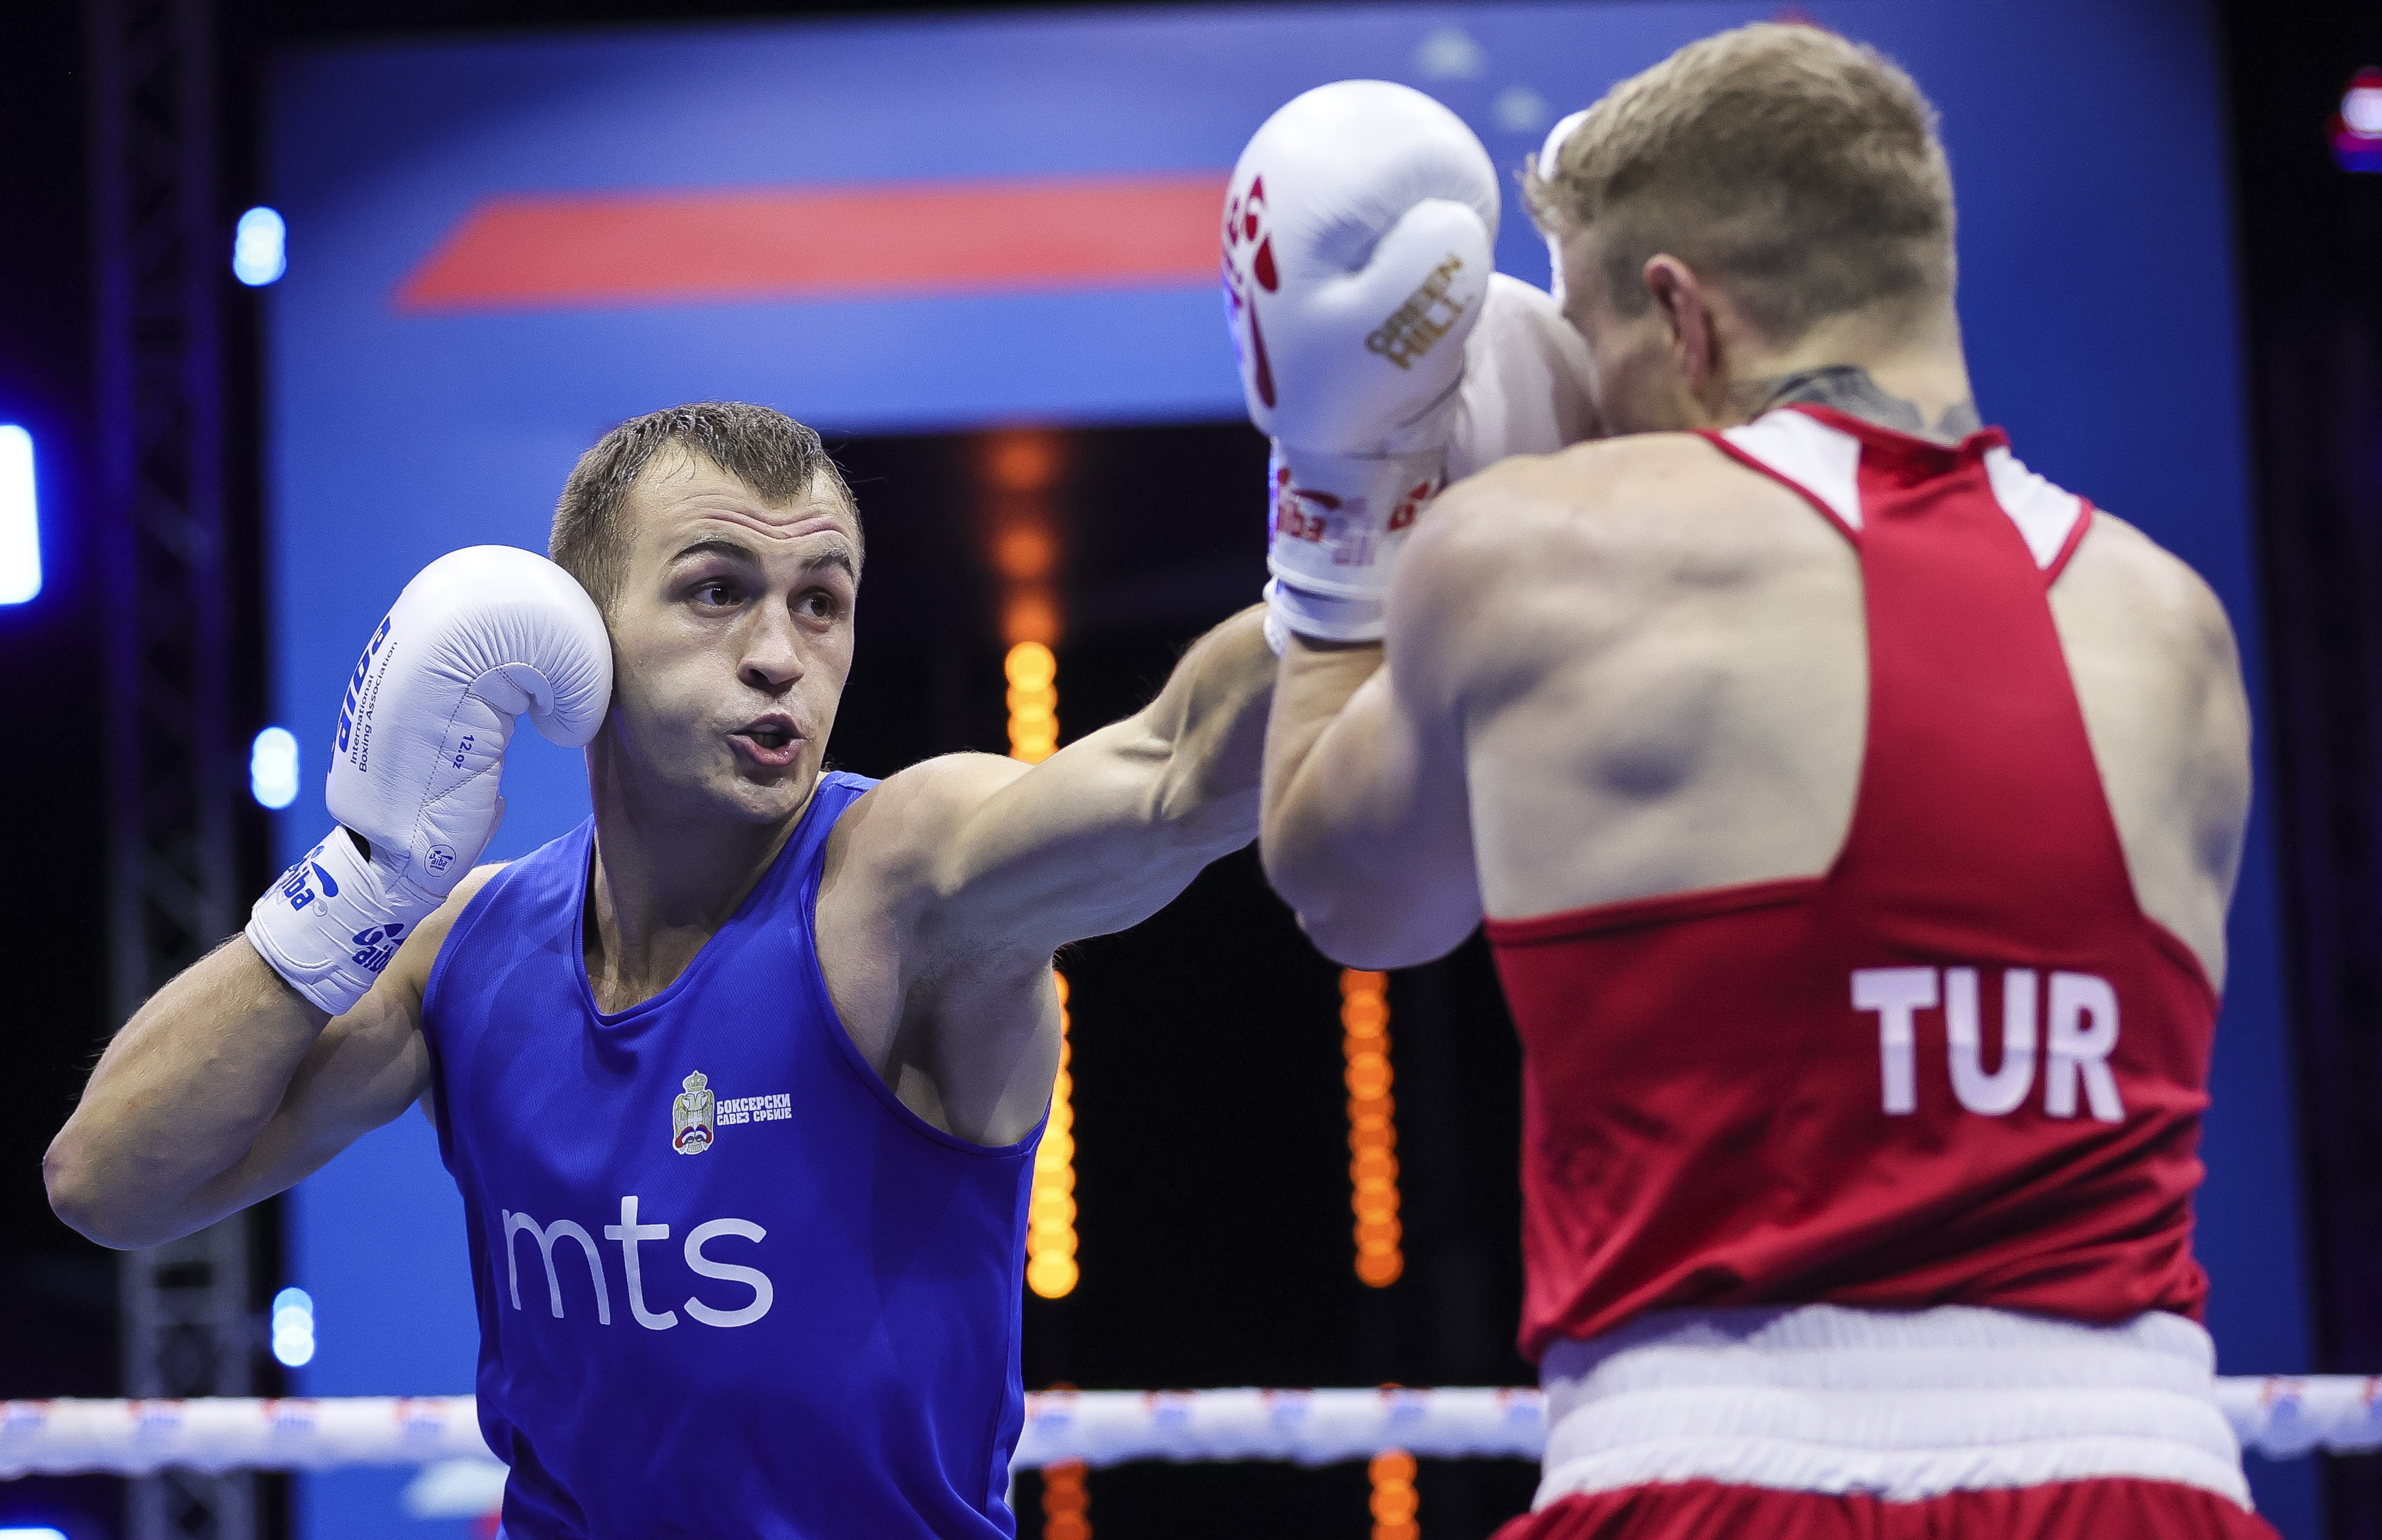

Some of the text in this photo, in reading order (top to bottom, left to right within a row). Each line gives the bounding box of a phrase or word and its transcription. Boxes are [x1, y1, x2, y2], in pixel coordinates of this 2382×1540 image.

[350, 674, 374, 764] International
[359, 642, 398, 772] Boxing Association
[282, 866, 315, 911] iba
[352, 944, 394, 974] aib
[1851, 965, 2125, 1123] TUR
[716, 1093, 791, 1115] БОКСЕРСКИ
[717, 1108, 792, 1126] САВЕЗ СРБИЈЕ
[502, 1196, 773, 1330] mts
